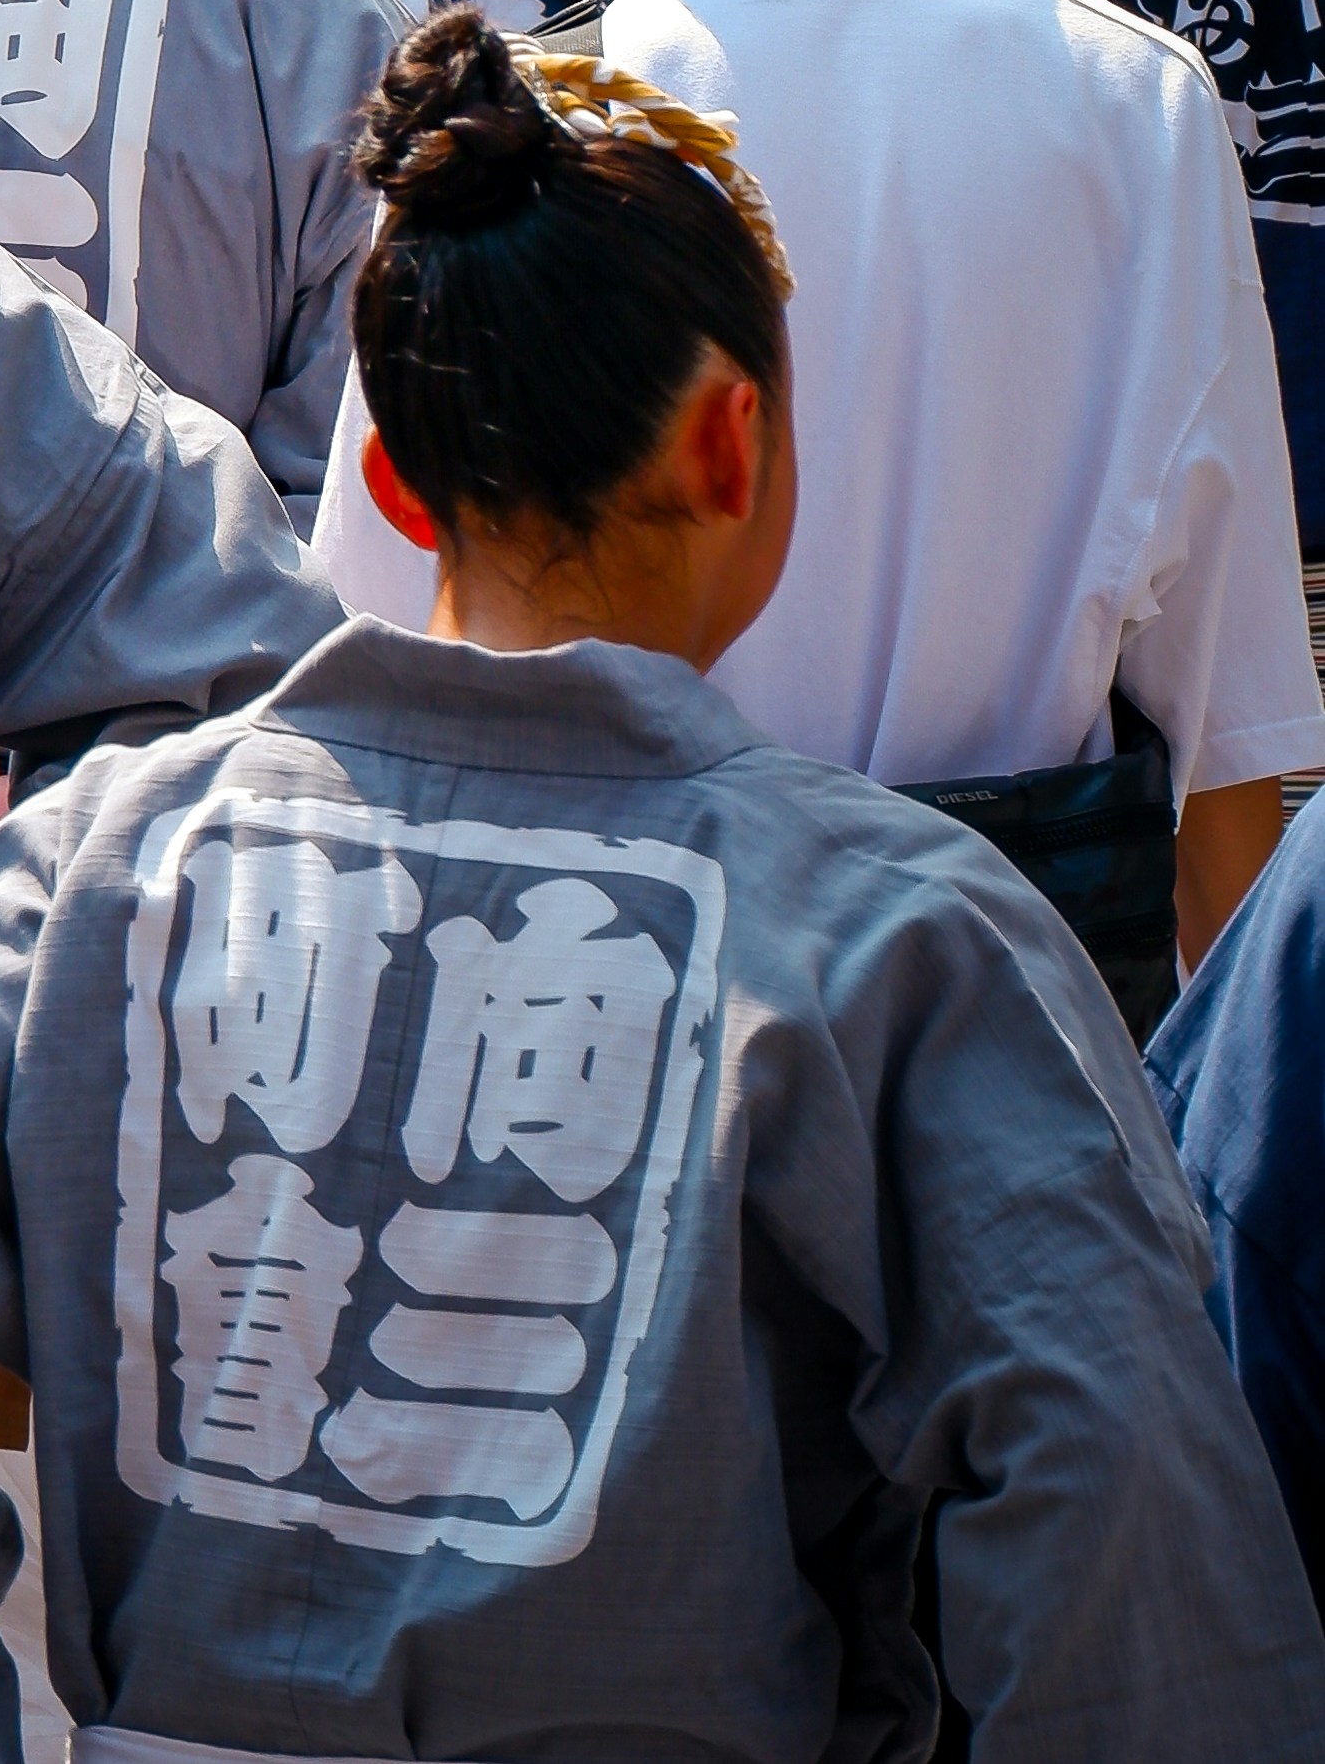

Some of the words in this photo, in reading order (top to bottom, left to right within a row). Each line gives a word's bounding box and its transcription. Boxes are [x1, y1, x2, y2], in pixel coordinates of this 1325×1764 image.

[935, 789, 999, 806] DIESEL
[161, 840, 424, 1481] 町會
[319, 878, 676, 1521] 向三
